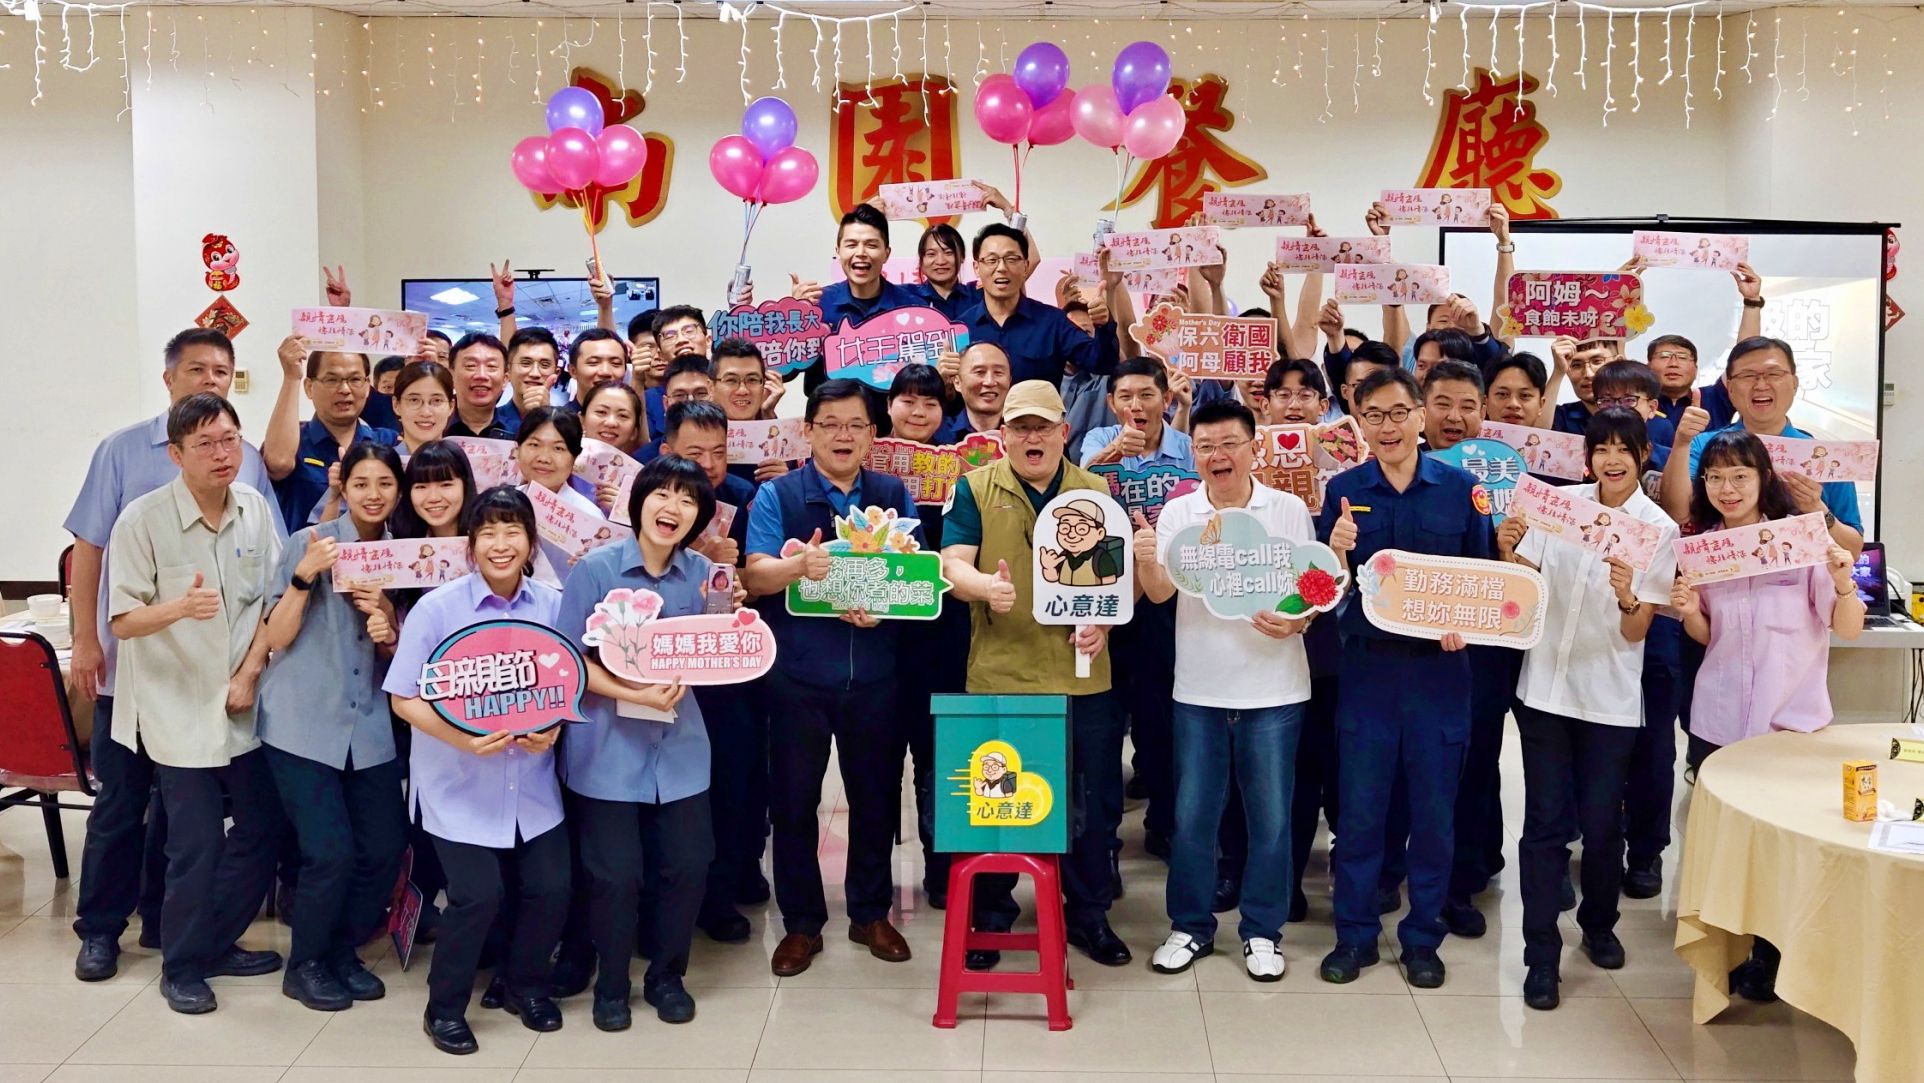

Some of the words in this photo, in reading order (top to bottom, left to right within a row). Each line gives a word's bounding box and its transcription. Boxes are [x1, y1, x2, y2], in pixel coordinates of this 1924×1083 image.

[706, 309, 821, 338] 你陪我長大
[1208, 319, 1221, 328] Day
[1524, 309, 1616, 328] 食飽未呀？
[1177, 322, 1272, 348] 保六衛國
[1178, 350, 1273, 375] 阿母顧我
[1180, 542, 1293, 571] 無線電call我
[798, 579, 934, 606] 也想你煮的菜
[1211, 571, 1295, 597] 心裡call妳
[1403, 568, 1505, 600] 勤務滿檔
[1045, 594, 1120, 617] 心意達
[1401, 597, 1503, 630] 想妳無限
[652, 631, 763, 656] 媽媽我愛你
[417, 650, 537, 700] 母親節
[652, 657, 686, 670] HAPPY
[687, 656, 740, 669] MOTHER'S
[742, 656, 763, 669] DAY
[464, 685, 566, 721] HAPPY!!
[977, 801, 1034, 820] 心意達
